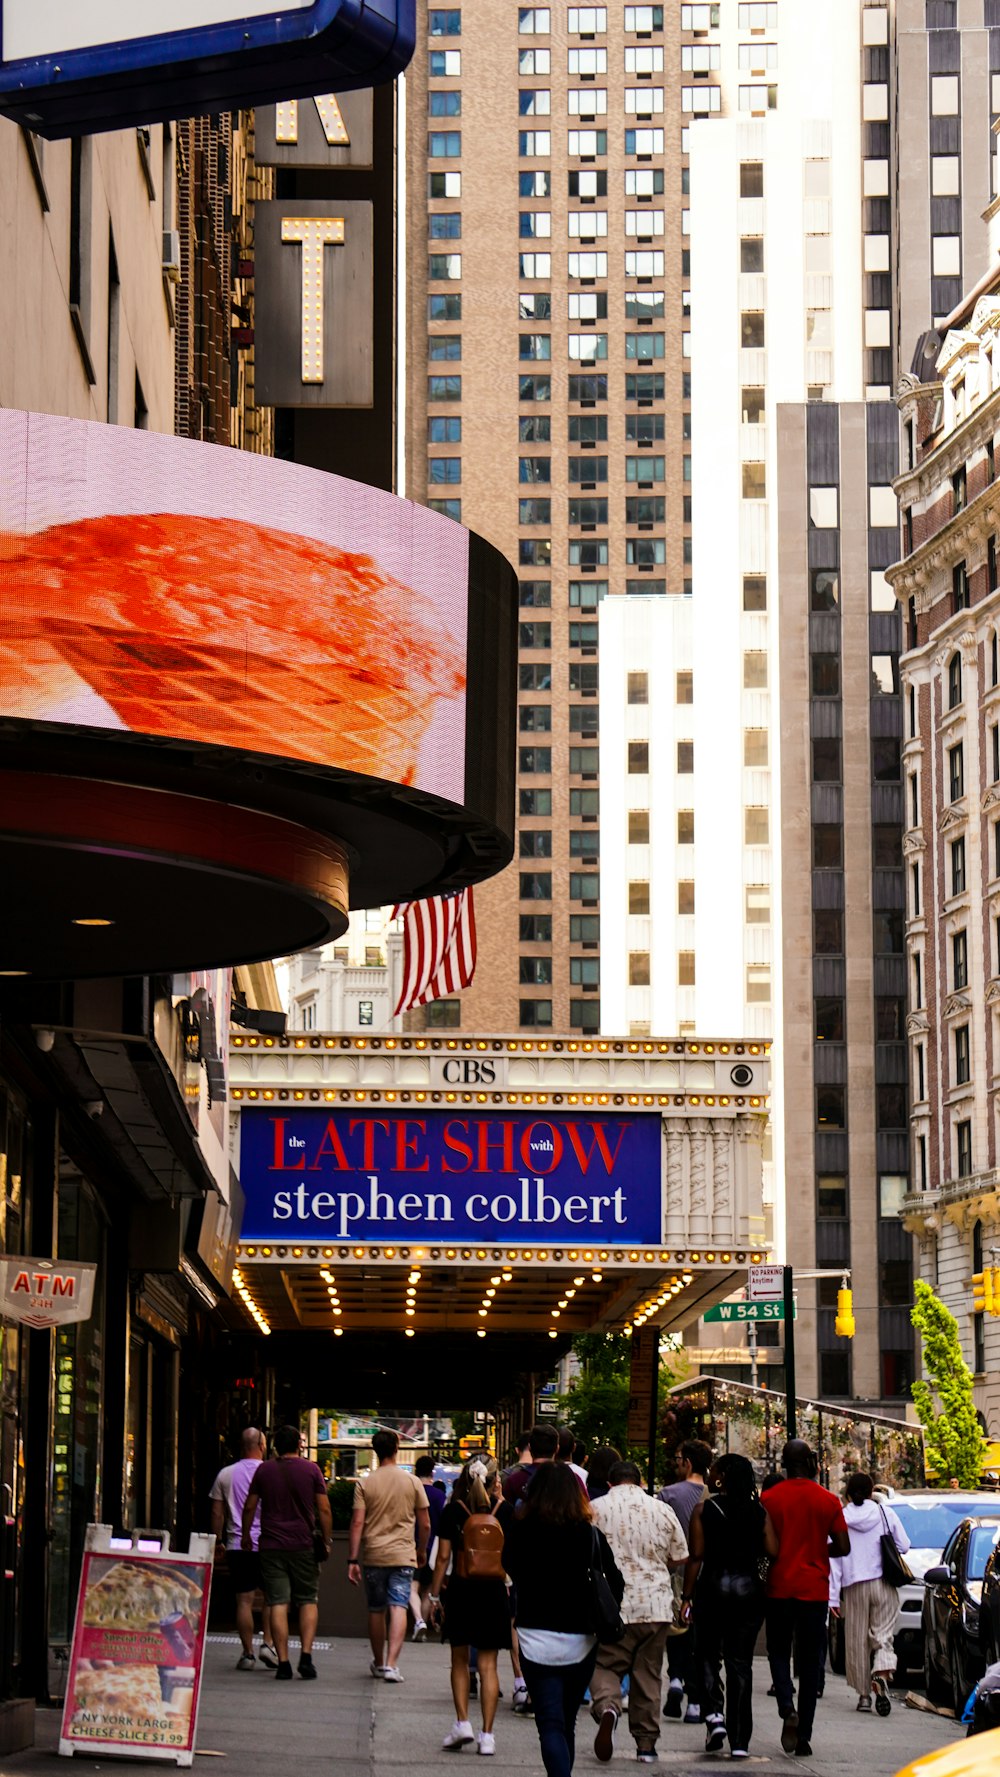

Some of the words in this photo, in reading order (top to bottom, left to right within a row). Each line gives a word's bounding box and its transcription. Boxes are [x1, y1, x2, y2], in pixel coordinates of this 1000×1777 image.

[442, 1059, 496, 1084] CBS
[267, 1117, 430, 1172] LATE
[441, 1119, 633, 1176] SHOW
[288, 1136, 306, 1148] the
[530, 1140, 553, 1151] with
[273, 1175, 455, 1237] stephen
[465, 1177, 628, 1224] colbert
[760, 1268, 783, 1276] PARKING
[11, 1271, 76, 1298] ATM
[751, 1277, 774, 1285] Anytime
[30, 1298, 53, 1309] 24H
[719, 1306, 732, 1319] W
[737, 1305, 758, 1318] 54
[763, 1304, 780, 1317] St
[103, 1632, 137, 1643] Special
[140, 1635, 163, 1645] Offer
[82, 1713, 101, 1722] NY
[102, 1714, 133, 1726] YORK
[137, 1717, 174, 1730] LARGE
[72, 1726, 114, 1738] CHEESE
[118, 1729, 148, 1741] SLICE
[152, 1733, 183, 1744] $1.99
